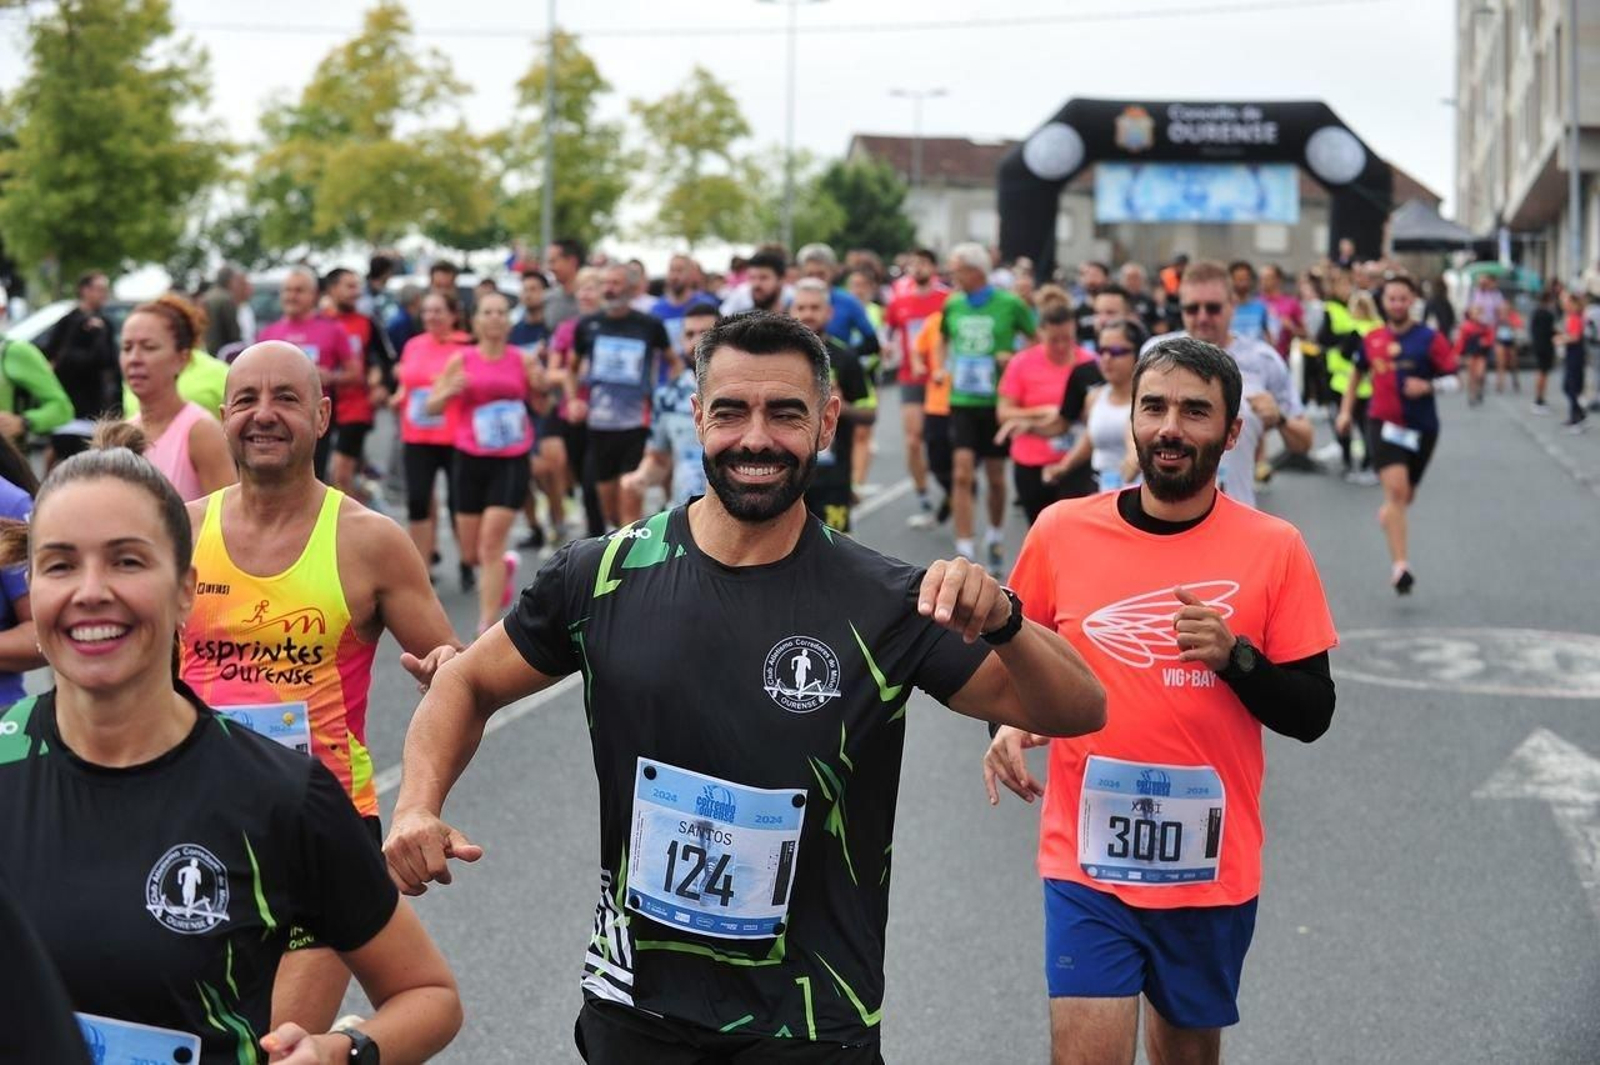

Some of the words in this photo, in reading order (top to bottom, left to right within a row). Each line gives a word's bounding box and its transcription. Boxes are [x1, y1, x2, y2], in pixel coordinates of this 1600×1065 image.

[1167, 121, 1278, 144] OURENSE
[768, 641, 793, 666] Atletismo
[795, 638, 830, 659] Corredores
[767, 667, 775, 686] Club
[780, 696, 818, 710] OURENSE
[1098, 779, 1120, 789] 2024
[1186, 786, 1209, 795] 2024
[652, 788, 678, 802] 2024
[755, 814, 783, 824] 2024
[678, 820, 732, 846] SANTOS
[1107, 815, 1183, 862] 300
[664, 839, 735, 907] 124
[166, 915, 207, 930] OURENSE
